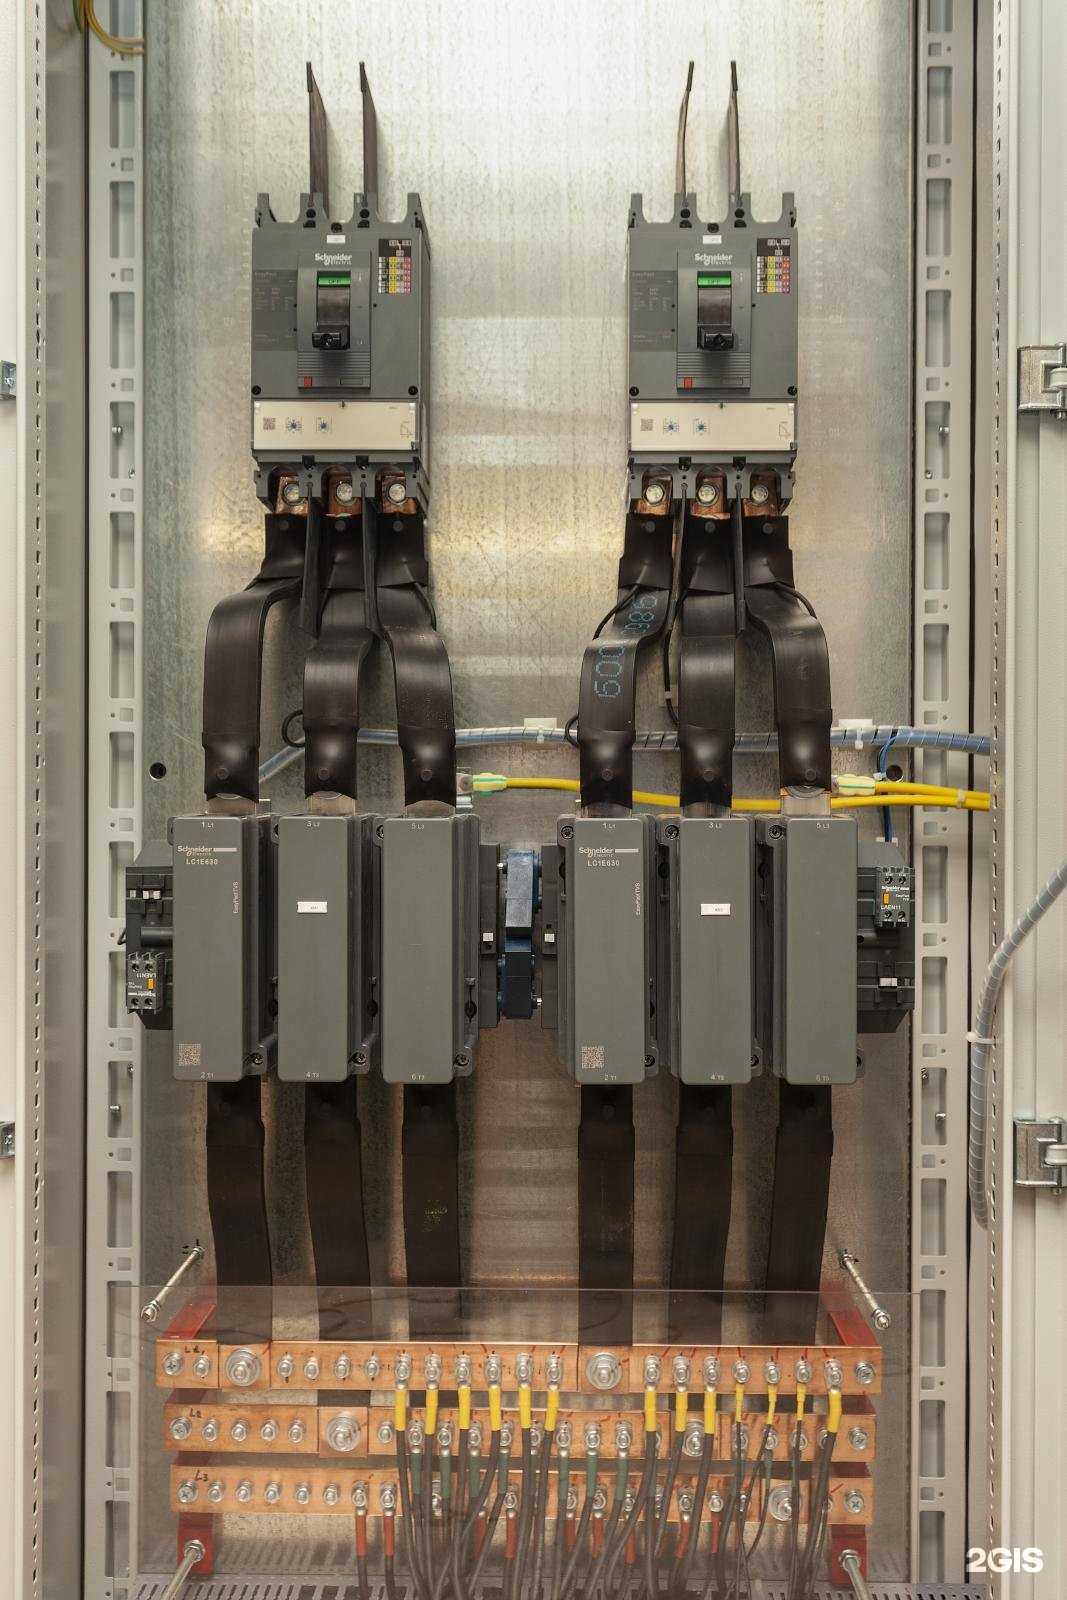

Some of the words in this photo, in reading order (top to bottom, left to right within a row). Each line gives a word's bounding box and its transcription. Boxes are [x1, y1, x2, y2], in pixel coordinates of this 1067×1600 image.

[314, 252, 353, 266] Schneider
[694, 252, 733, 266] Schneider
[177, 844, 213, 857] Schneider
[578, 846, 614, 858] Schneider
[194, 1468, 209, 1482] L3
